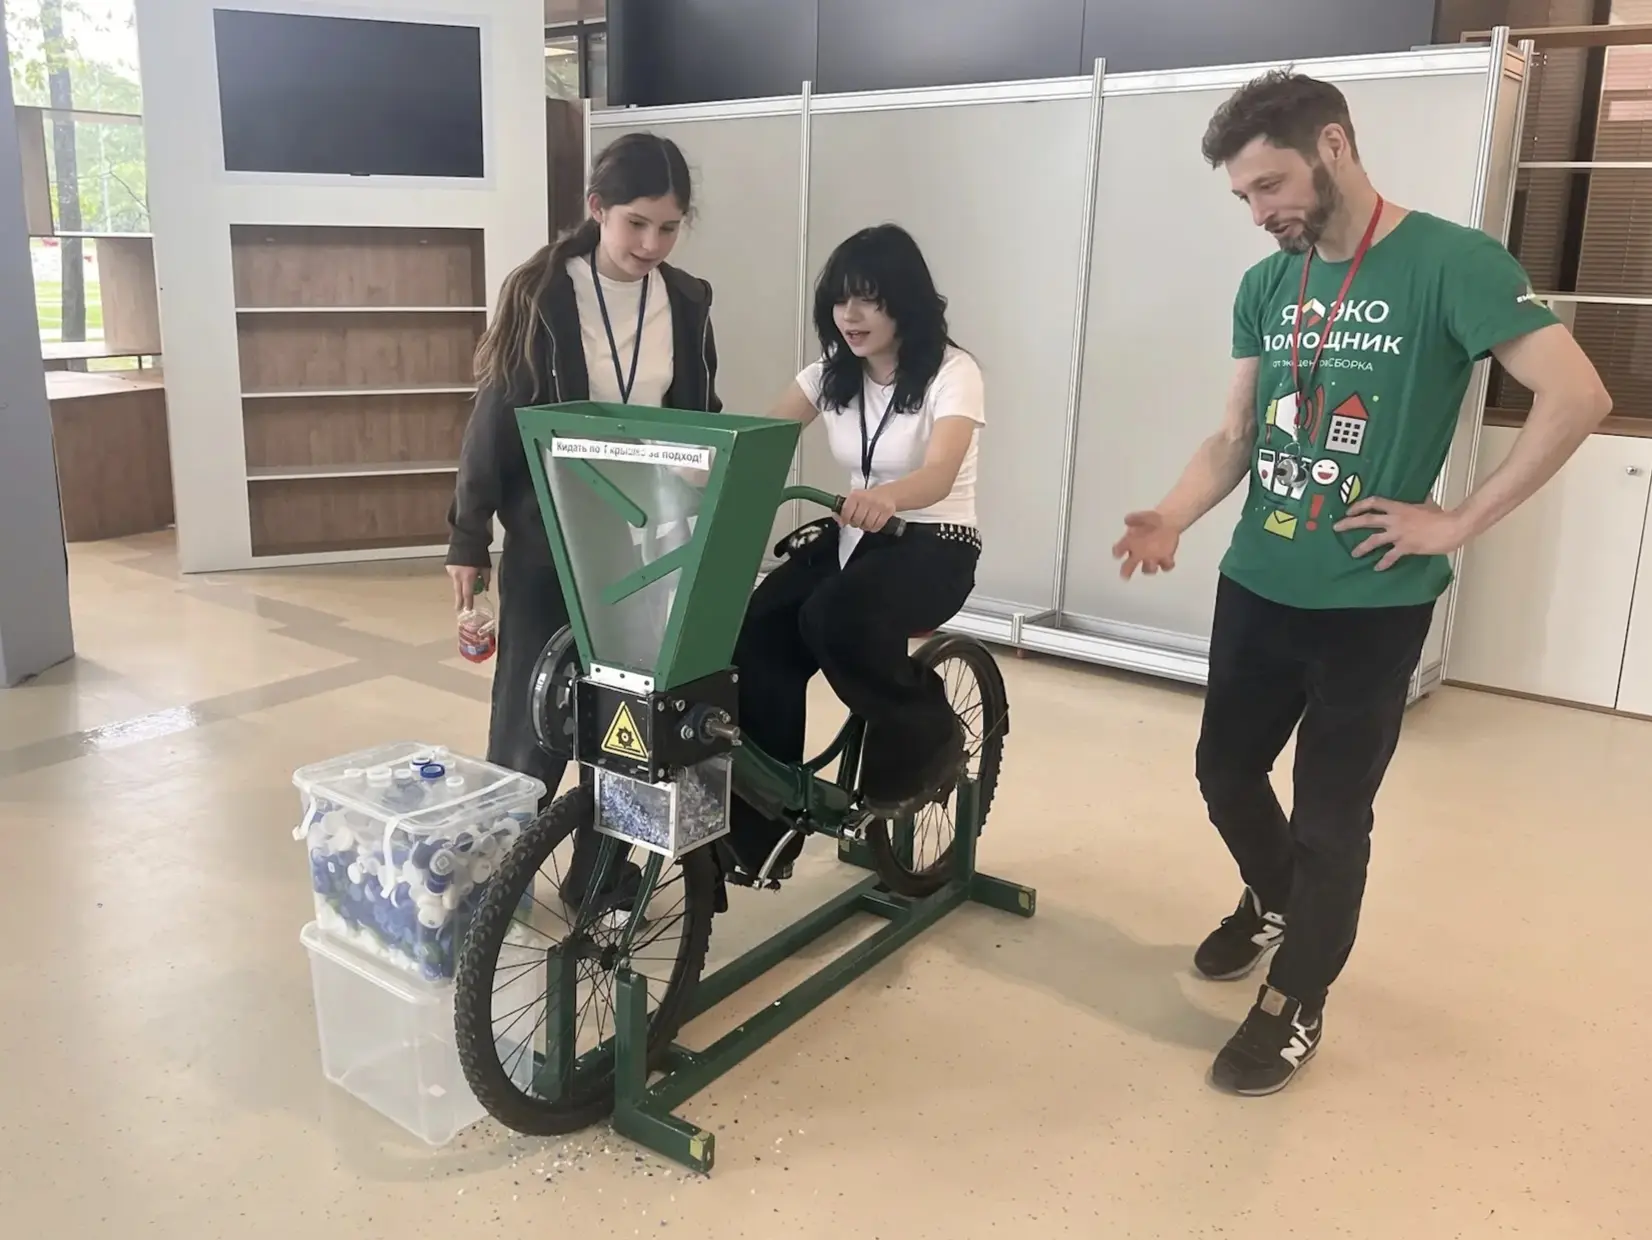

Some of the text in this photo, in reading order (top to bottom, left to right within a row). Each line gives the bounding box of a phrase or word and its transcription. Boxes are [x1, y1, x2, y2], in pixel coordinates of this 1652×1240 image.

[1280, 299, 1390, 326] Я ЭКО
[556, 441, 587, 454] Кидать
[589, 444, 600, 454] по
[609, 446, 646, 457] кры
[662, 452, 703, 463] подход!
